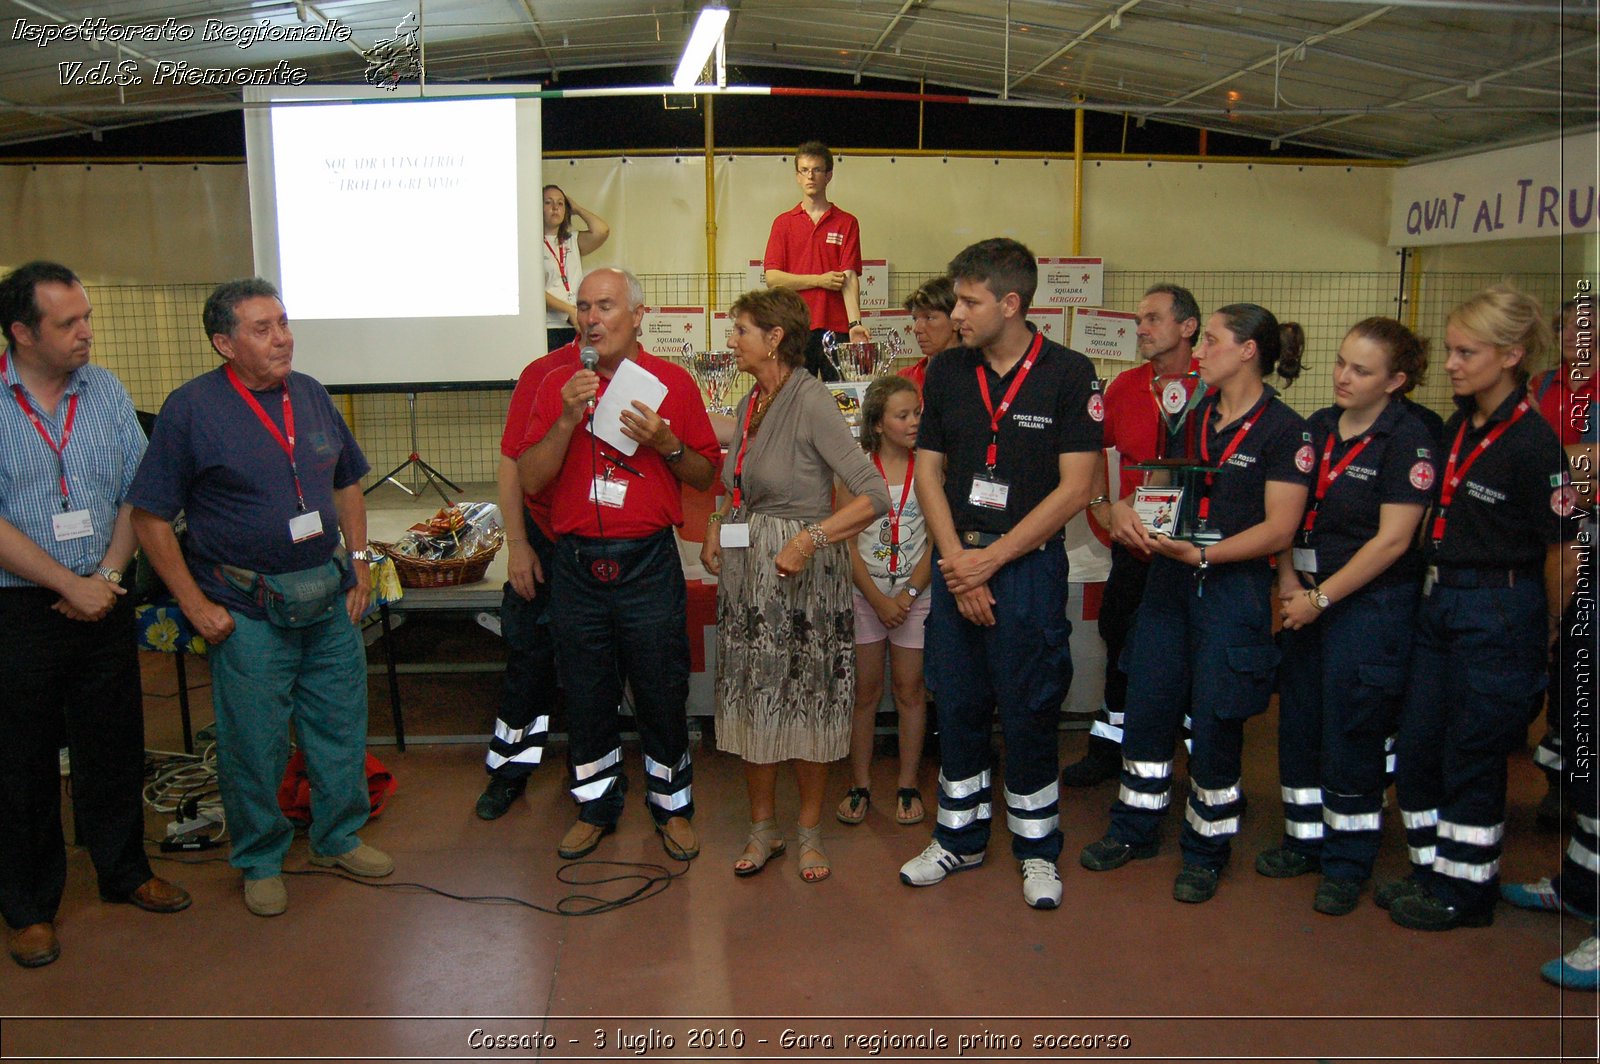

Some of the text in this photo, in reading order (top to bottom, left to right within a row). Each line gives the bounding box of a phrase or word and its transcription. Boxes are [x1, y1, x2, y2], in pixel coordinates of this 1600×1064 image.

[1407, 192, 1466, 236] QUAT
[1516, 179, 1600, 229] TRU
[1091, 339, 1118, 347] SQUADRA
[1084, 347, 1122, 357] MONCALVO
[1012, 414, 1053, 424] CROCE ROSSA
[1018, 421, 1045, 430] ITALIANA
